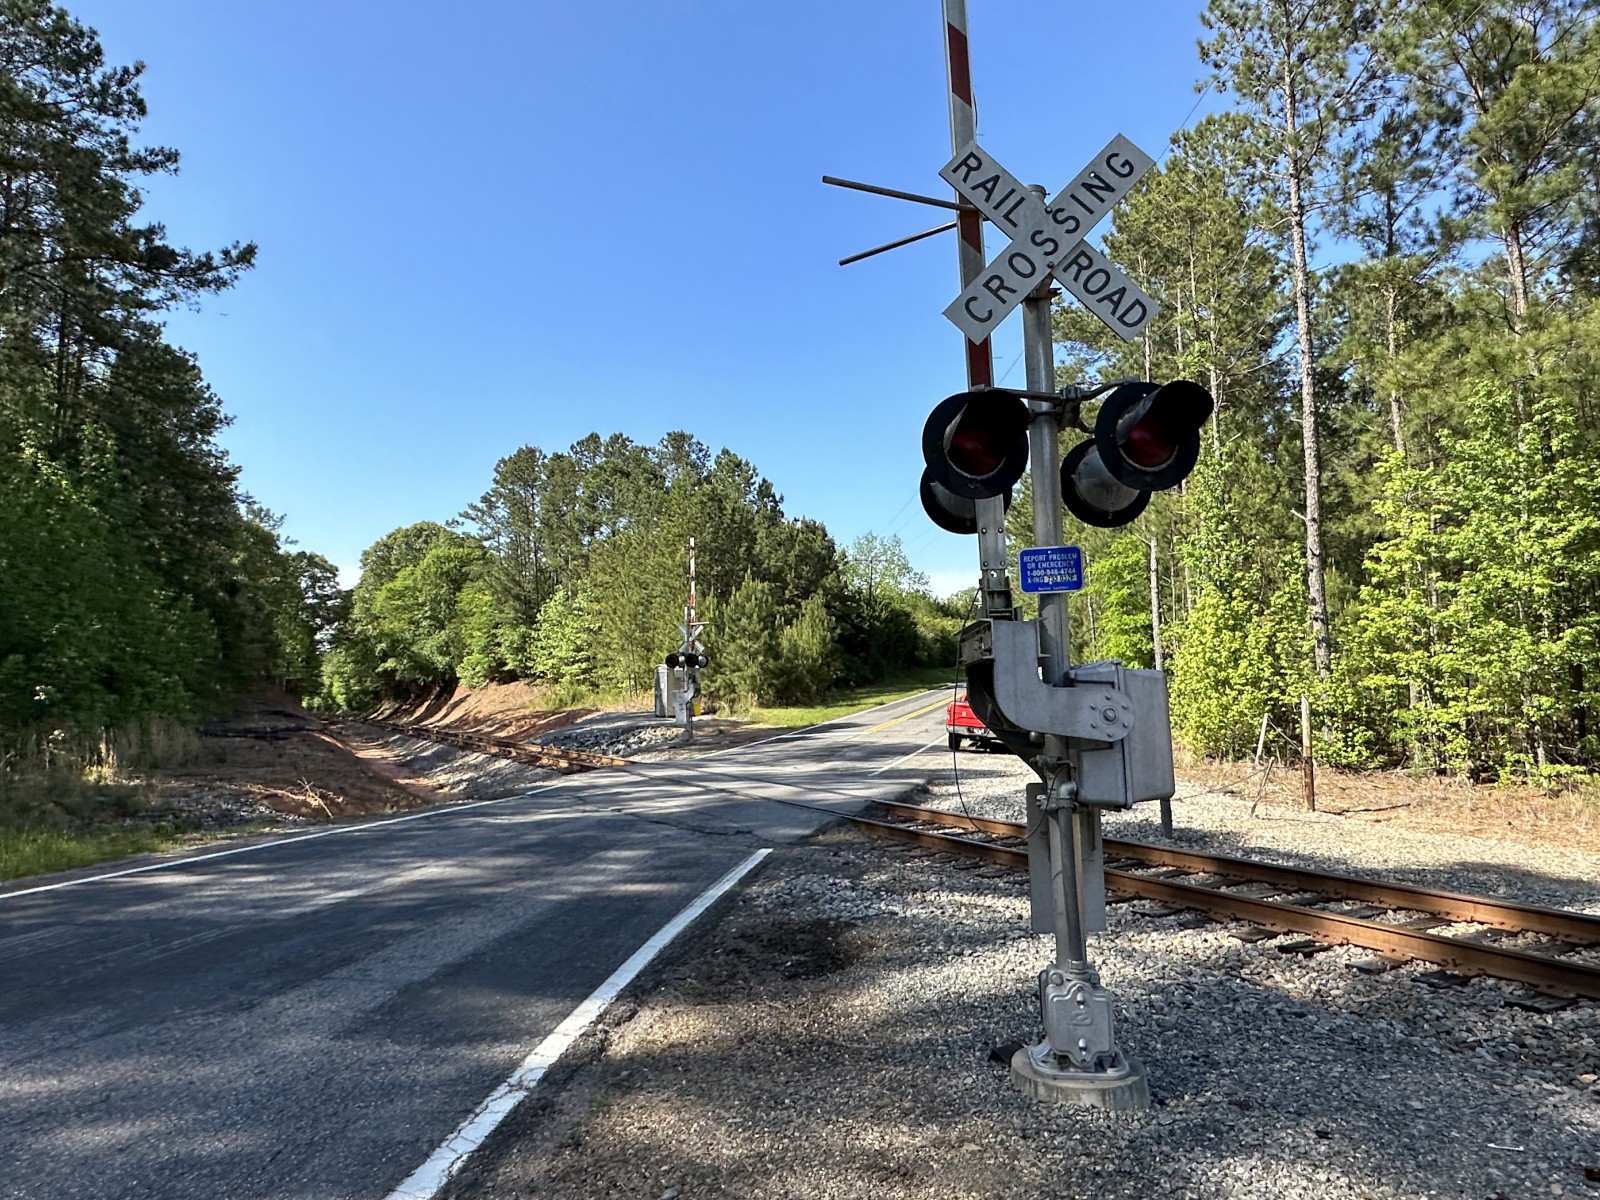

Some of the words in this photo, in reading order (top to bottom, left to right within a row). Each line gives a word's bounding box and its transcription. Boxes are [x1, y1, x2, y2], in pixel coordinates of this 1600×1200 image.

[951, 151, 1026, 228] RAIL
[1062, 249, 1147, 328] ROAD
[964, 152, 1134, 323] CROSSING
[1023, 554, 1046, 562] REPORT
[1048, 553, 1077, 561] PROBLEM
[1038, 560, 1075, 568] EMERGENCY
